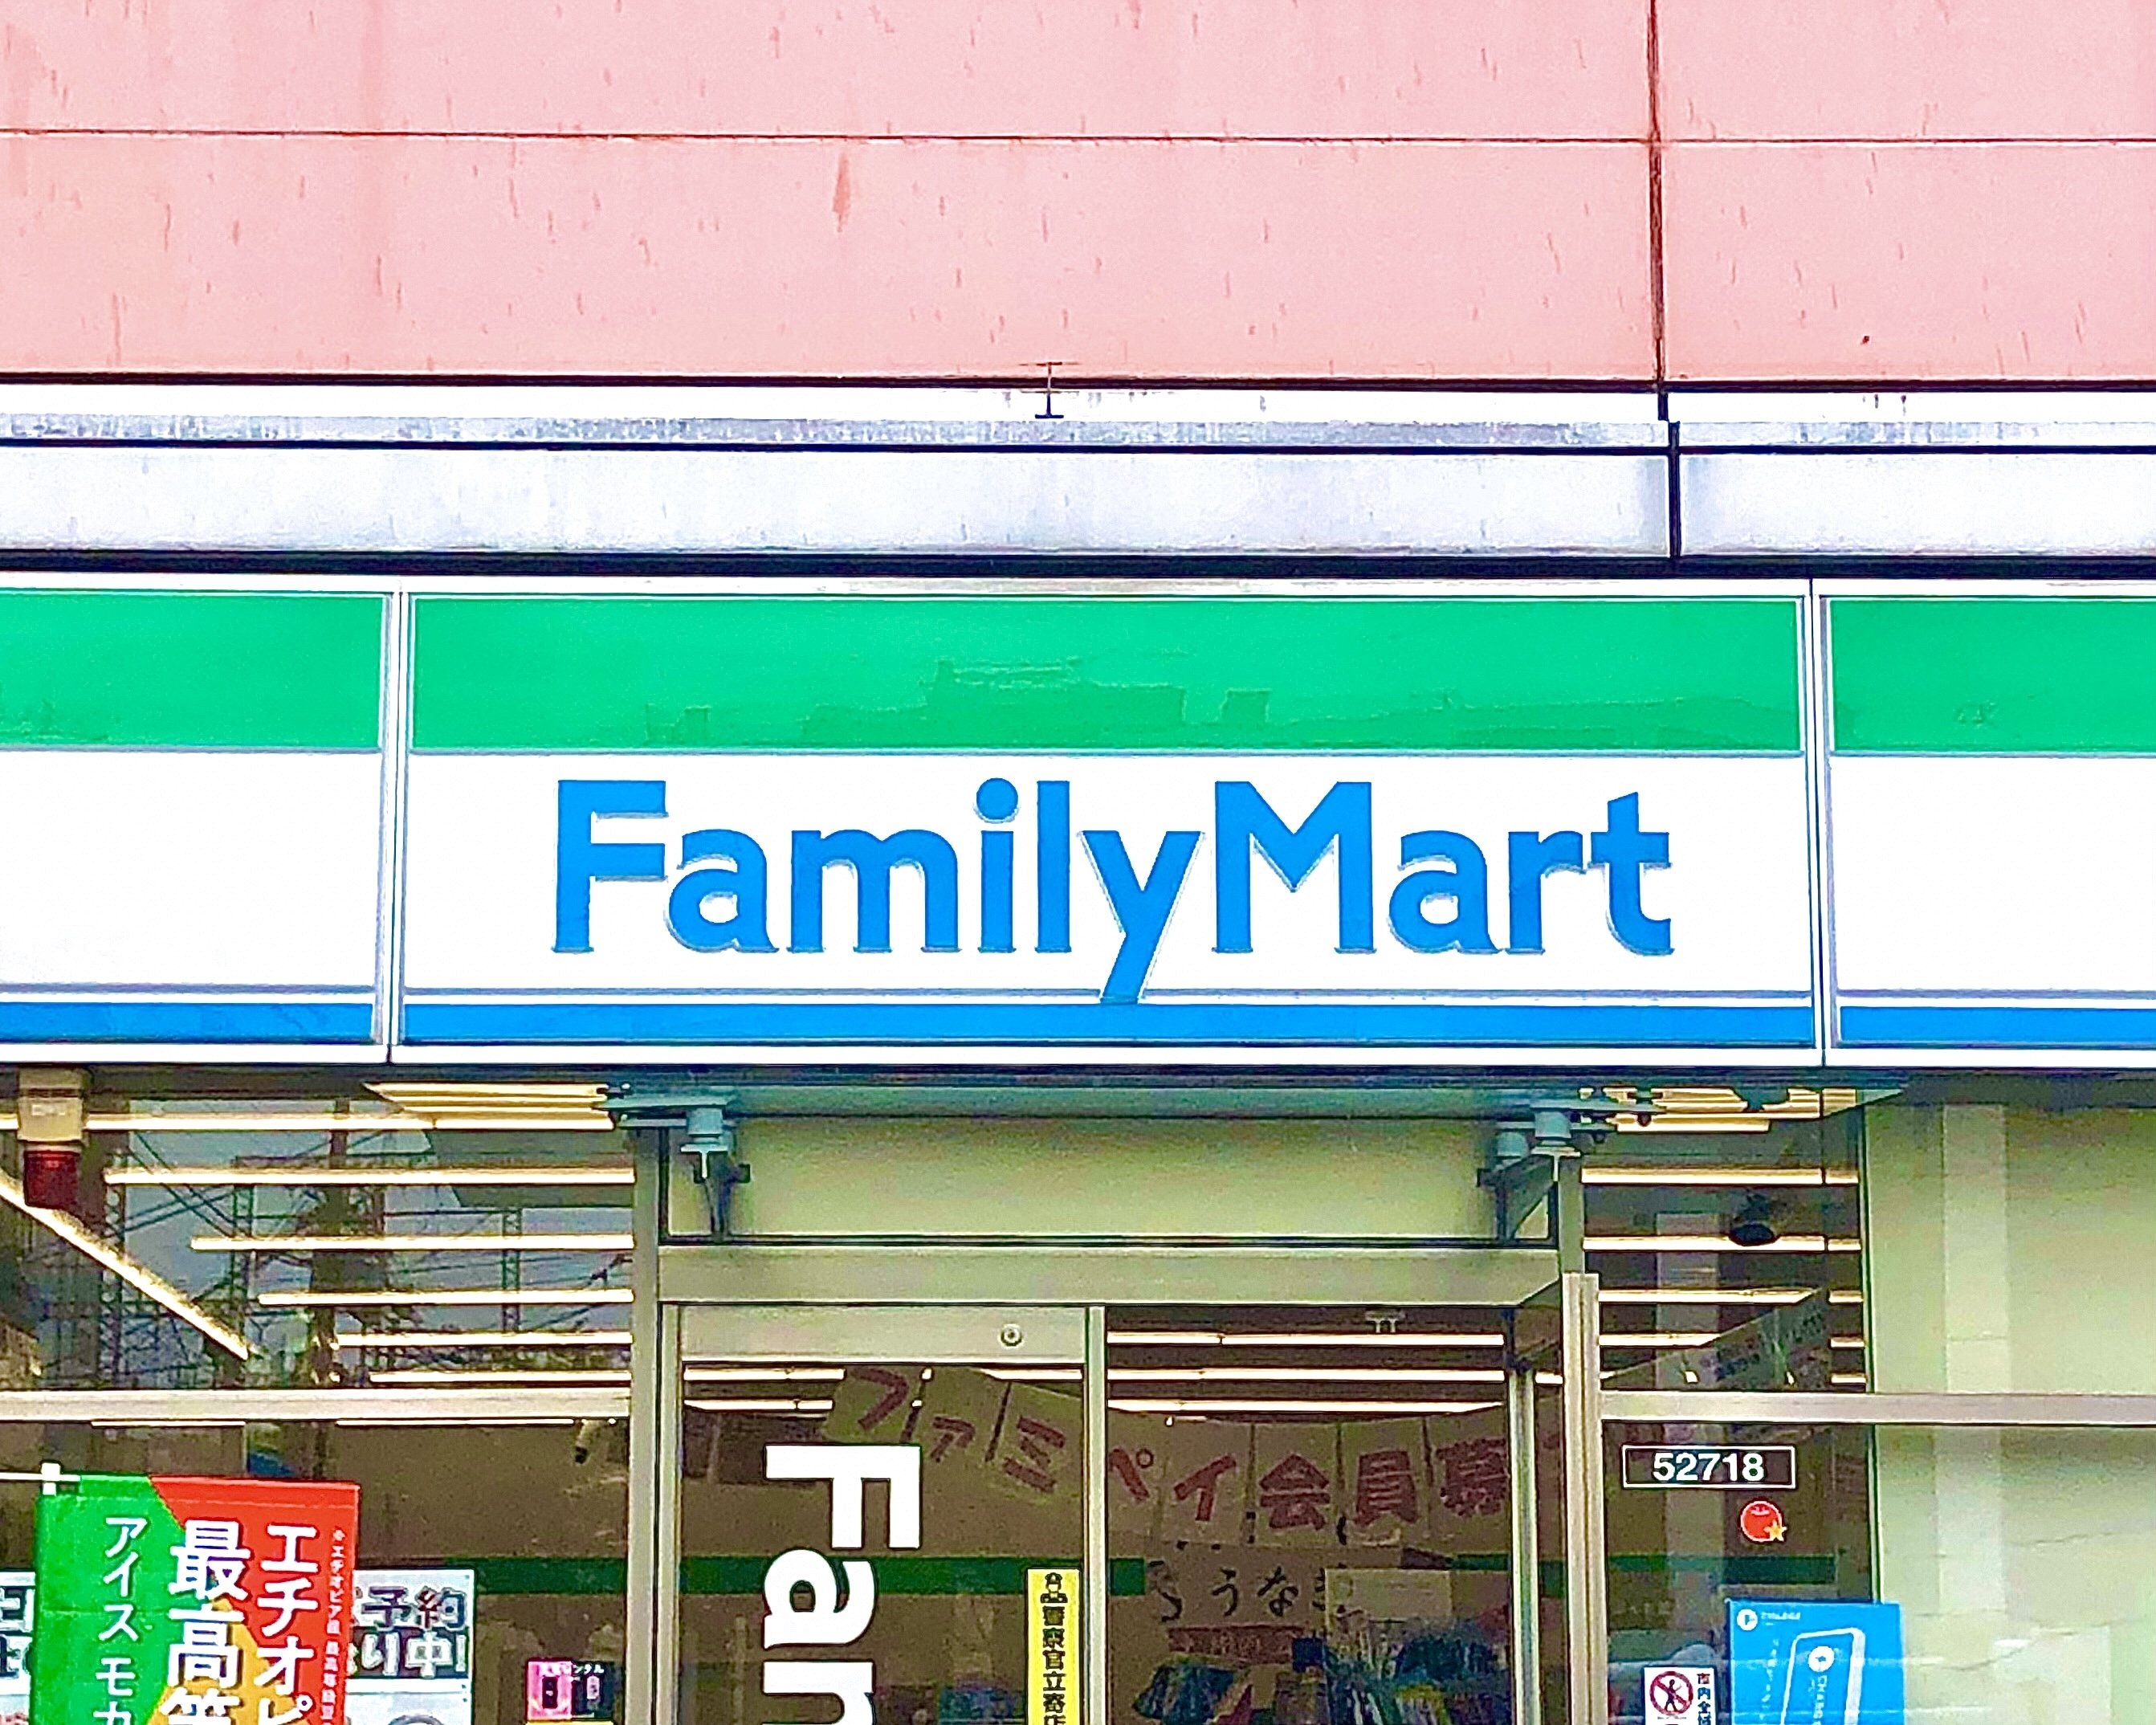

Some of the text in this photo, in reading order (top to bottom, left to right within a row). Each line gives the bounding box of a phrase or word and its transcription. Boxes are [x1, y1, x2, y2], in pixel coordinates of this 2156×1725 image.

[553, 778, 1674, 1004] FamilyMart
[1653, 1452, 1765, 1482] 52718
[354, 1585, 467, 1630] 予約
